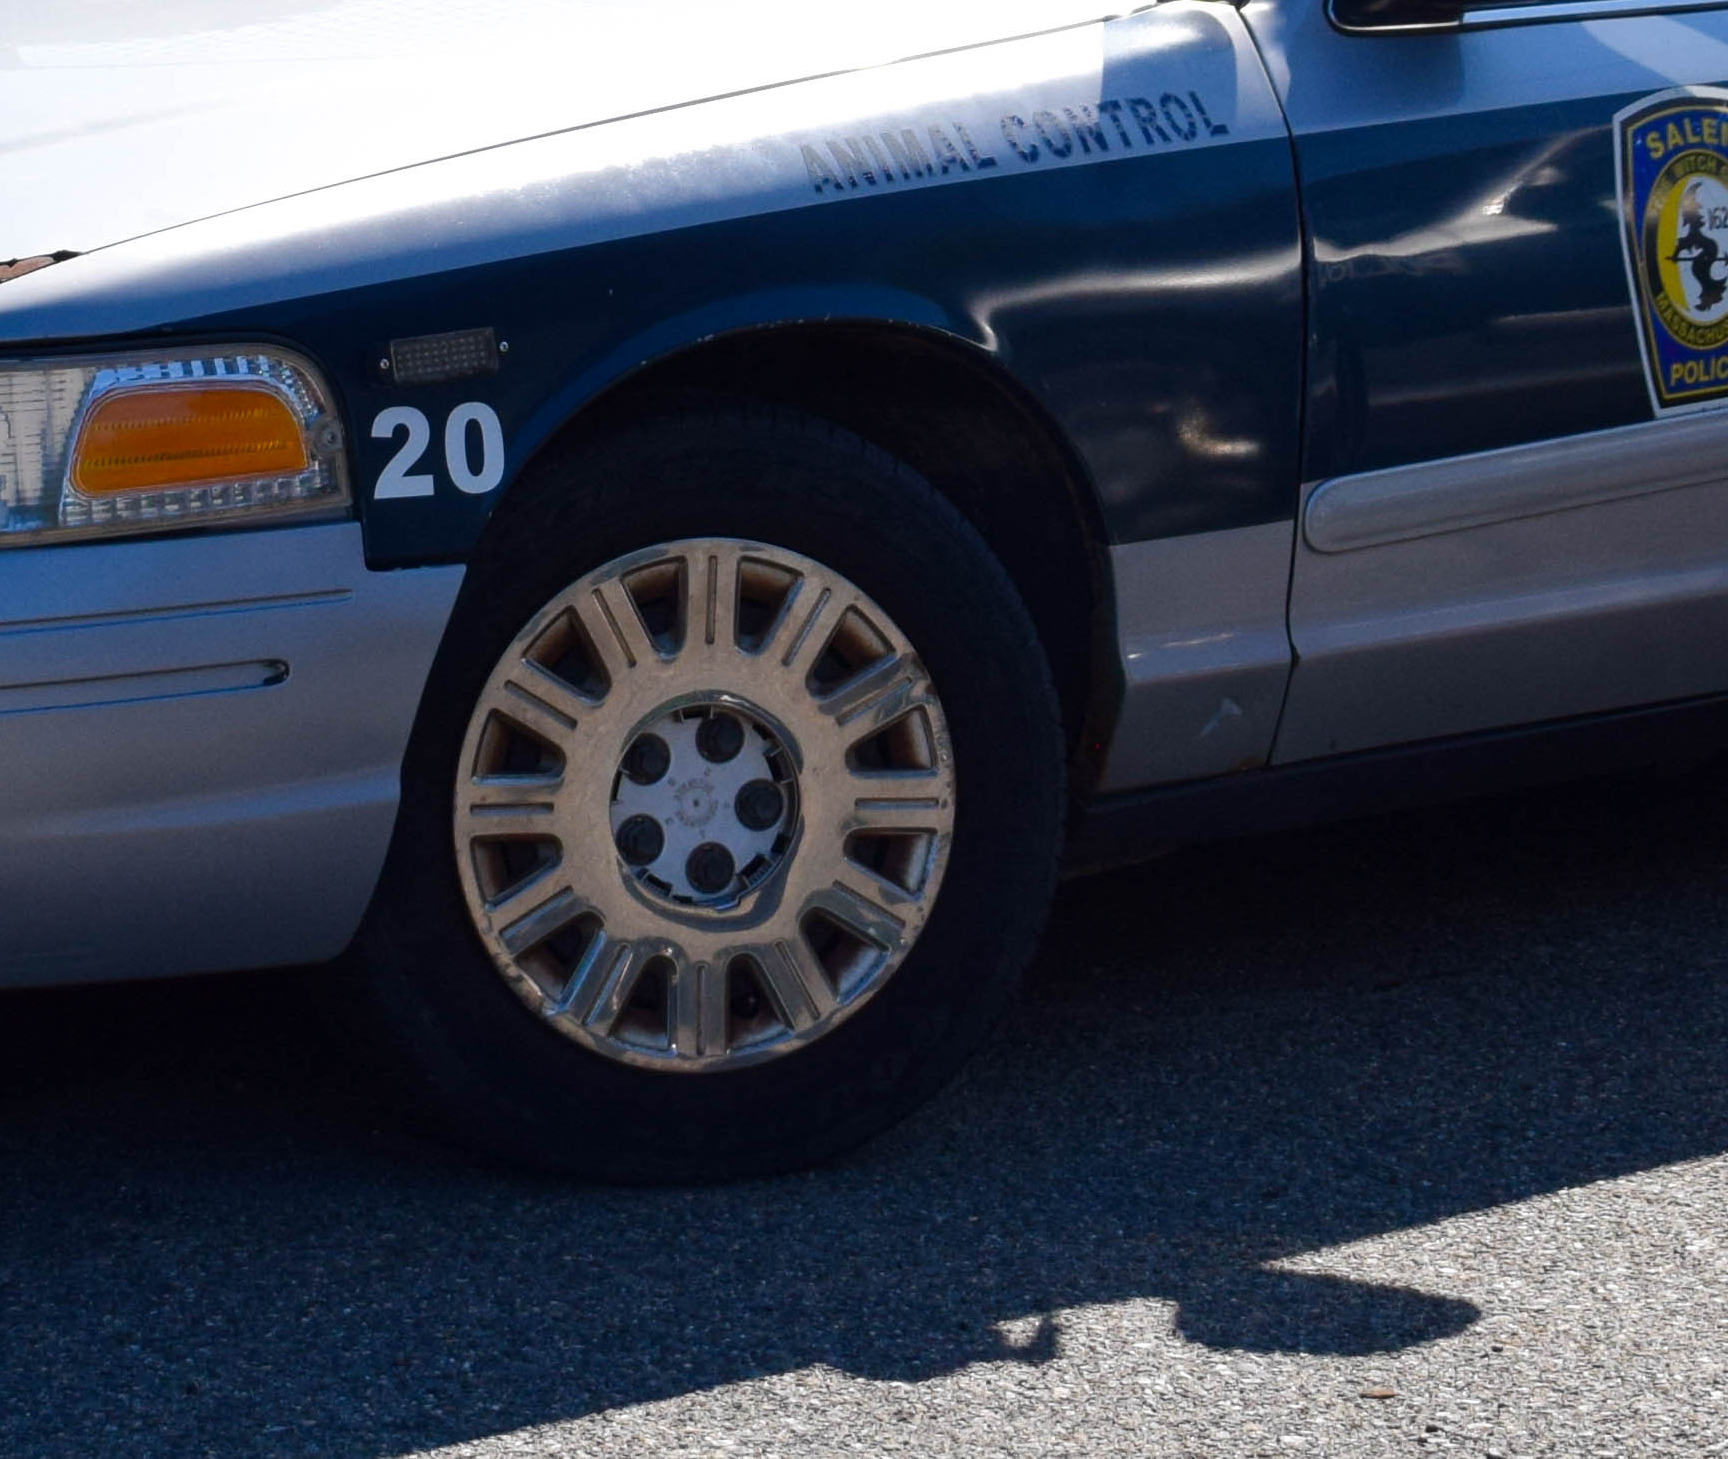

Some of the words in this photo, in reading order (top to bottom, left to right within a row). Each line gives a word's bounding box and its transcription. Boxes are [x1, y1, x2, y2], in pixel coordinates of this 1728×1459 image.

[800, 122, 999, 194] ANIMAL
[1001, 91, 1230, 163] CONTROL
[370, 401, 505, 500] 20
